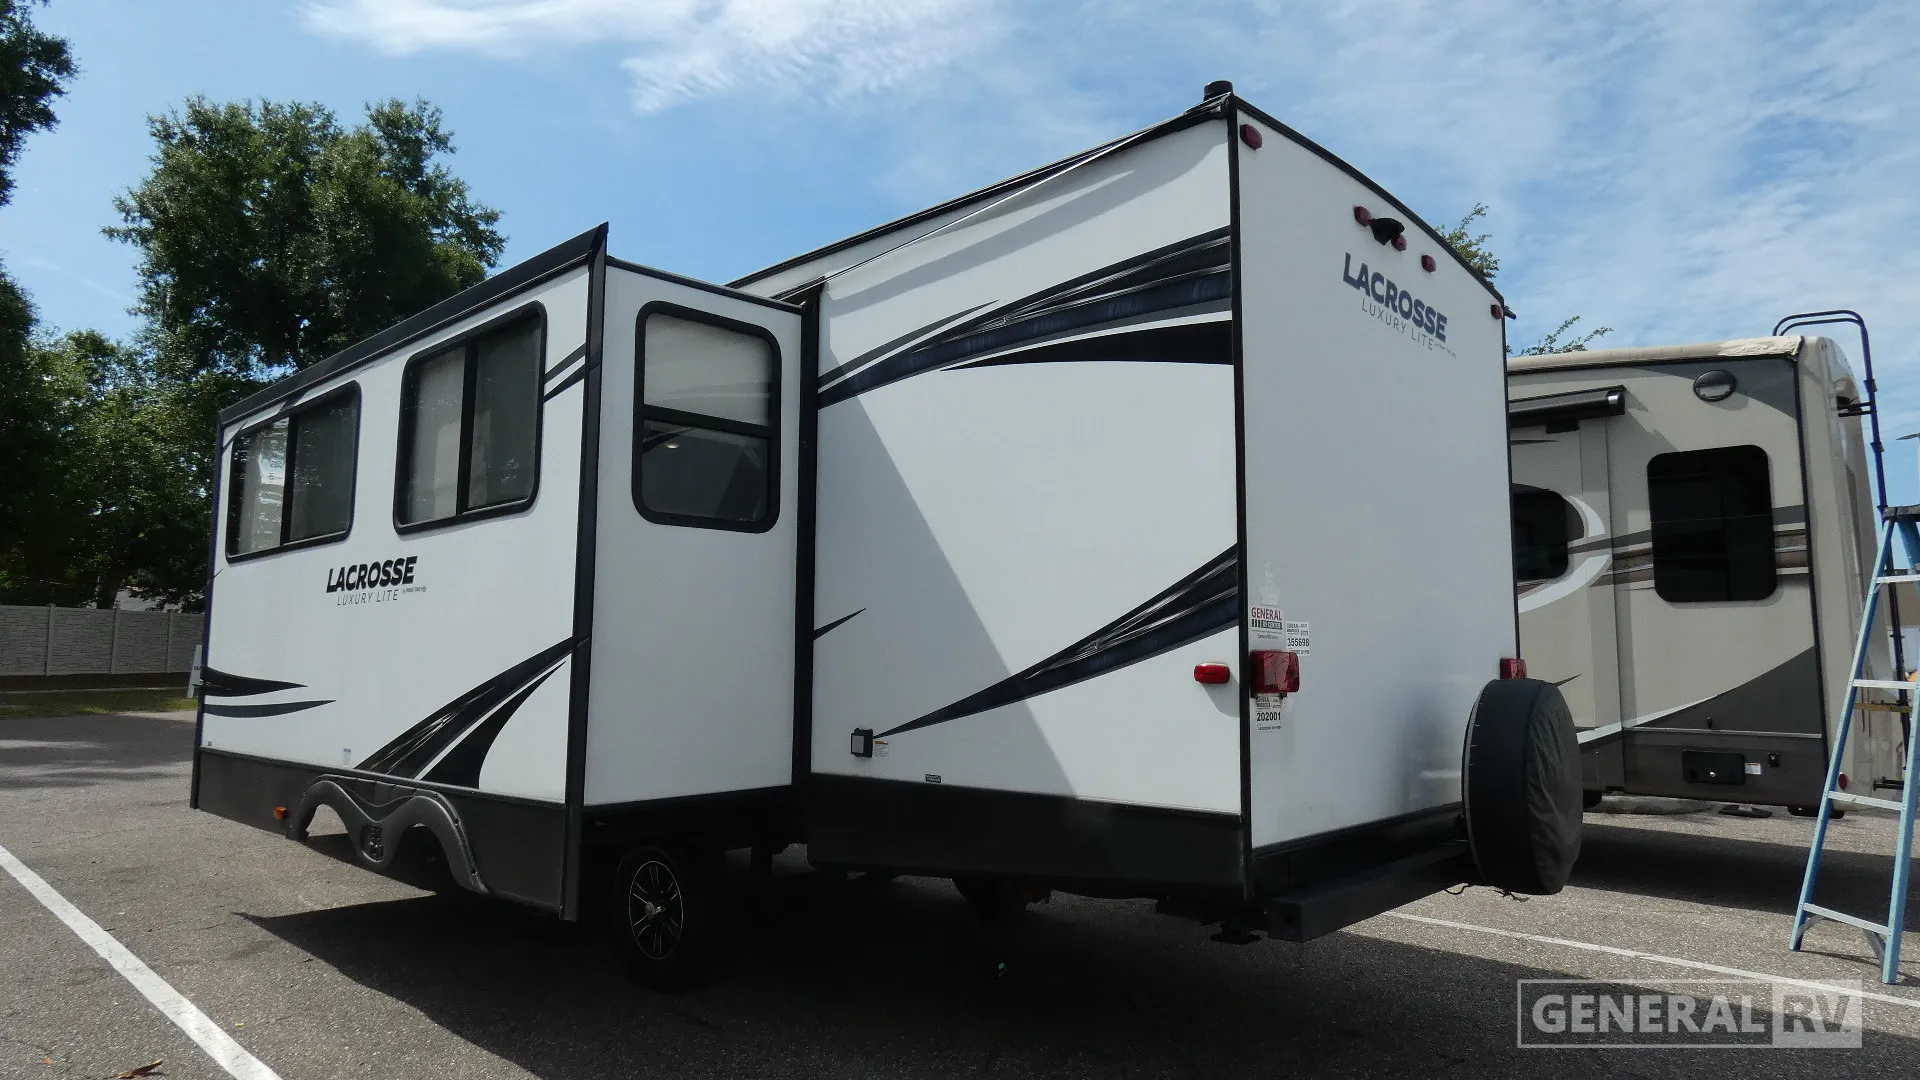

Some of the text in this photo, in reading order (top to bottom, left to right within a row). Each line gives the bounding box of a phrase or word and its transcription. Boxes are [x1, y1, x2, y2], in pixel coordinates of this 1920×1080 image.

[1343, 251, 1448, 343] LACROSSE
[1361, 298, 1407, 334] LUXURY
[1411, 327, 1434, 351] LITE
[326, 556, 418, 593] LACROSSE
[337, 592, 374, 606] LUXURY
[376, 589, 399, 603] LITE
[1251, 607, 1282, 621] GENERAL
[1256, 711, 1281, 721] 202001
